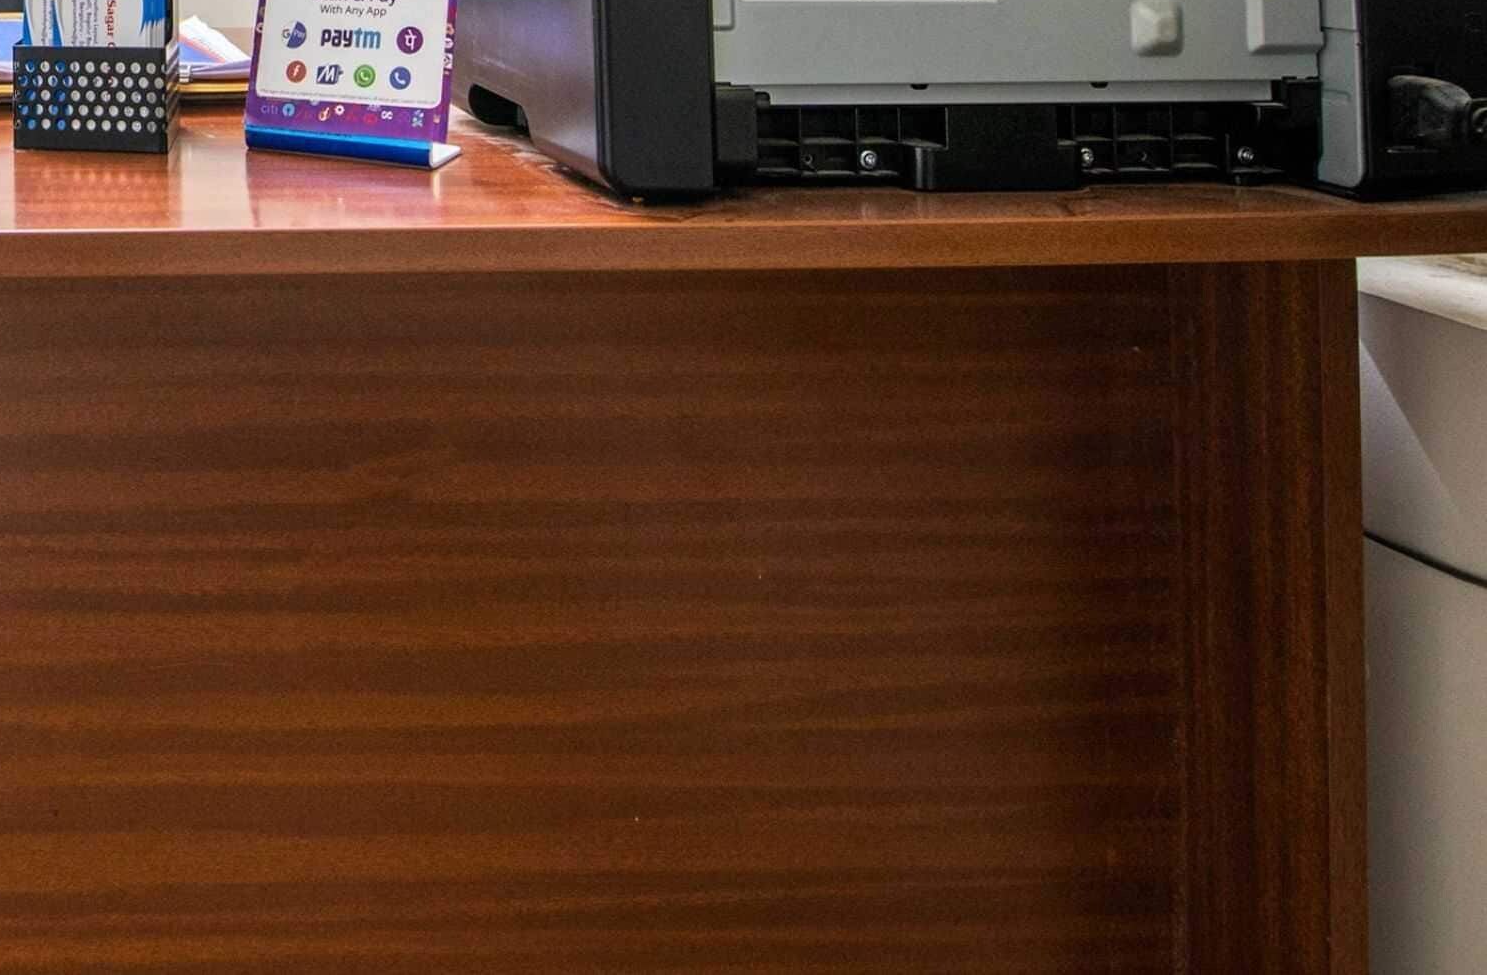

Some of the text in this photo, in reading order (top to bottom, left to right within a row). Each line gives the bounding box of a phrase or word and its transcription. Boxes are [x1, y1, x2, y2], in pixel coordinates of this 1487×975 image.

[104, 0, 117, 37] Sagar
[320, 4, 387, 18] With Any App
